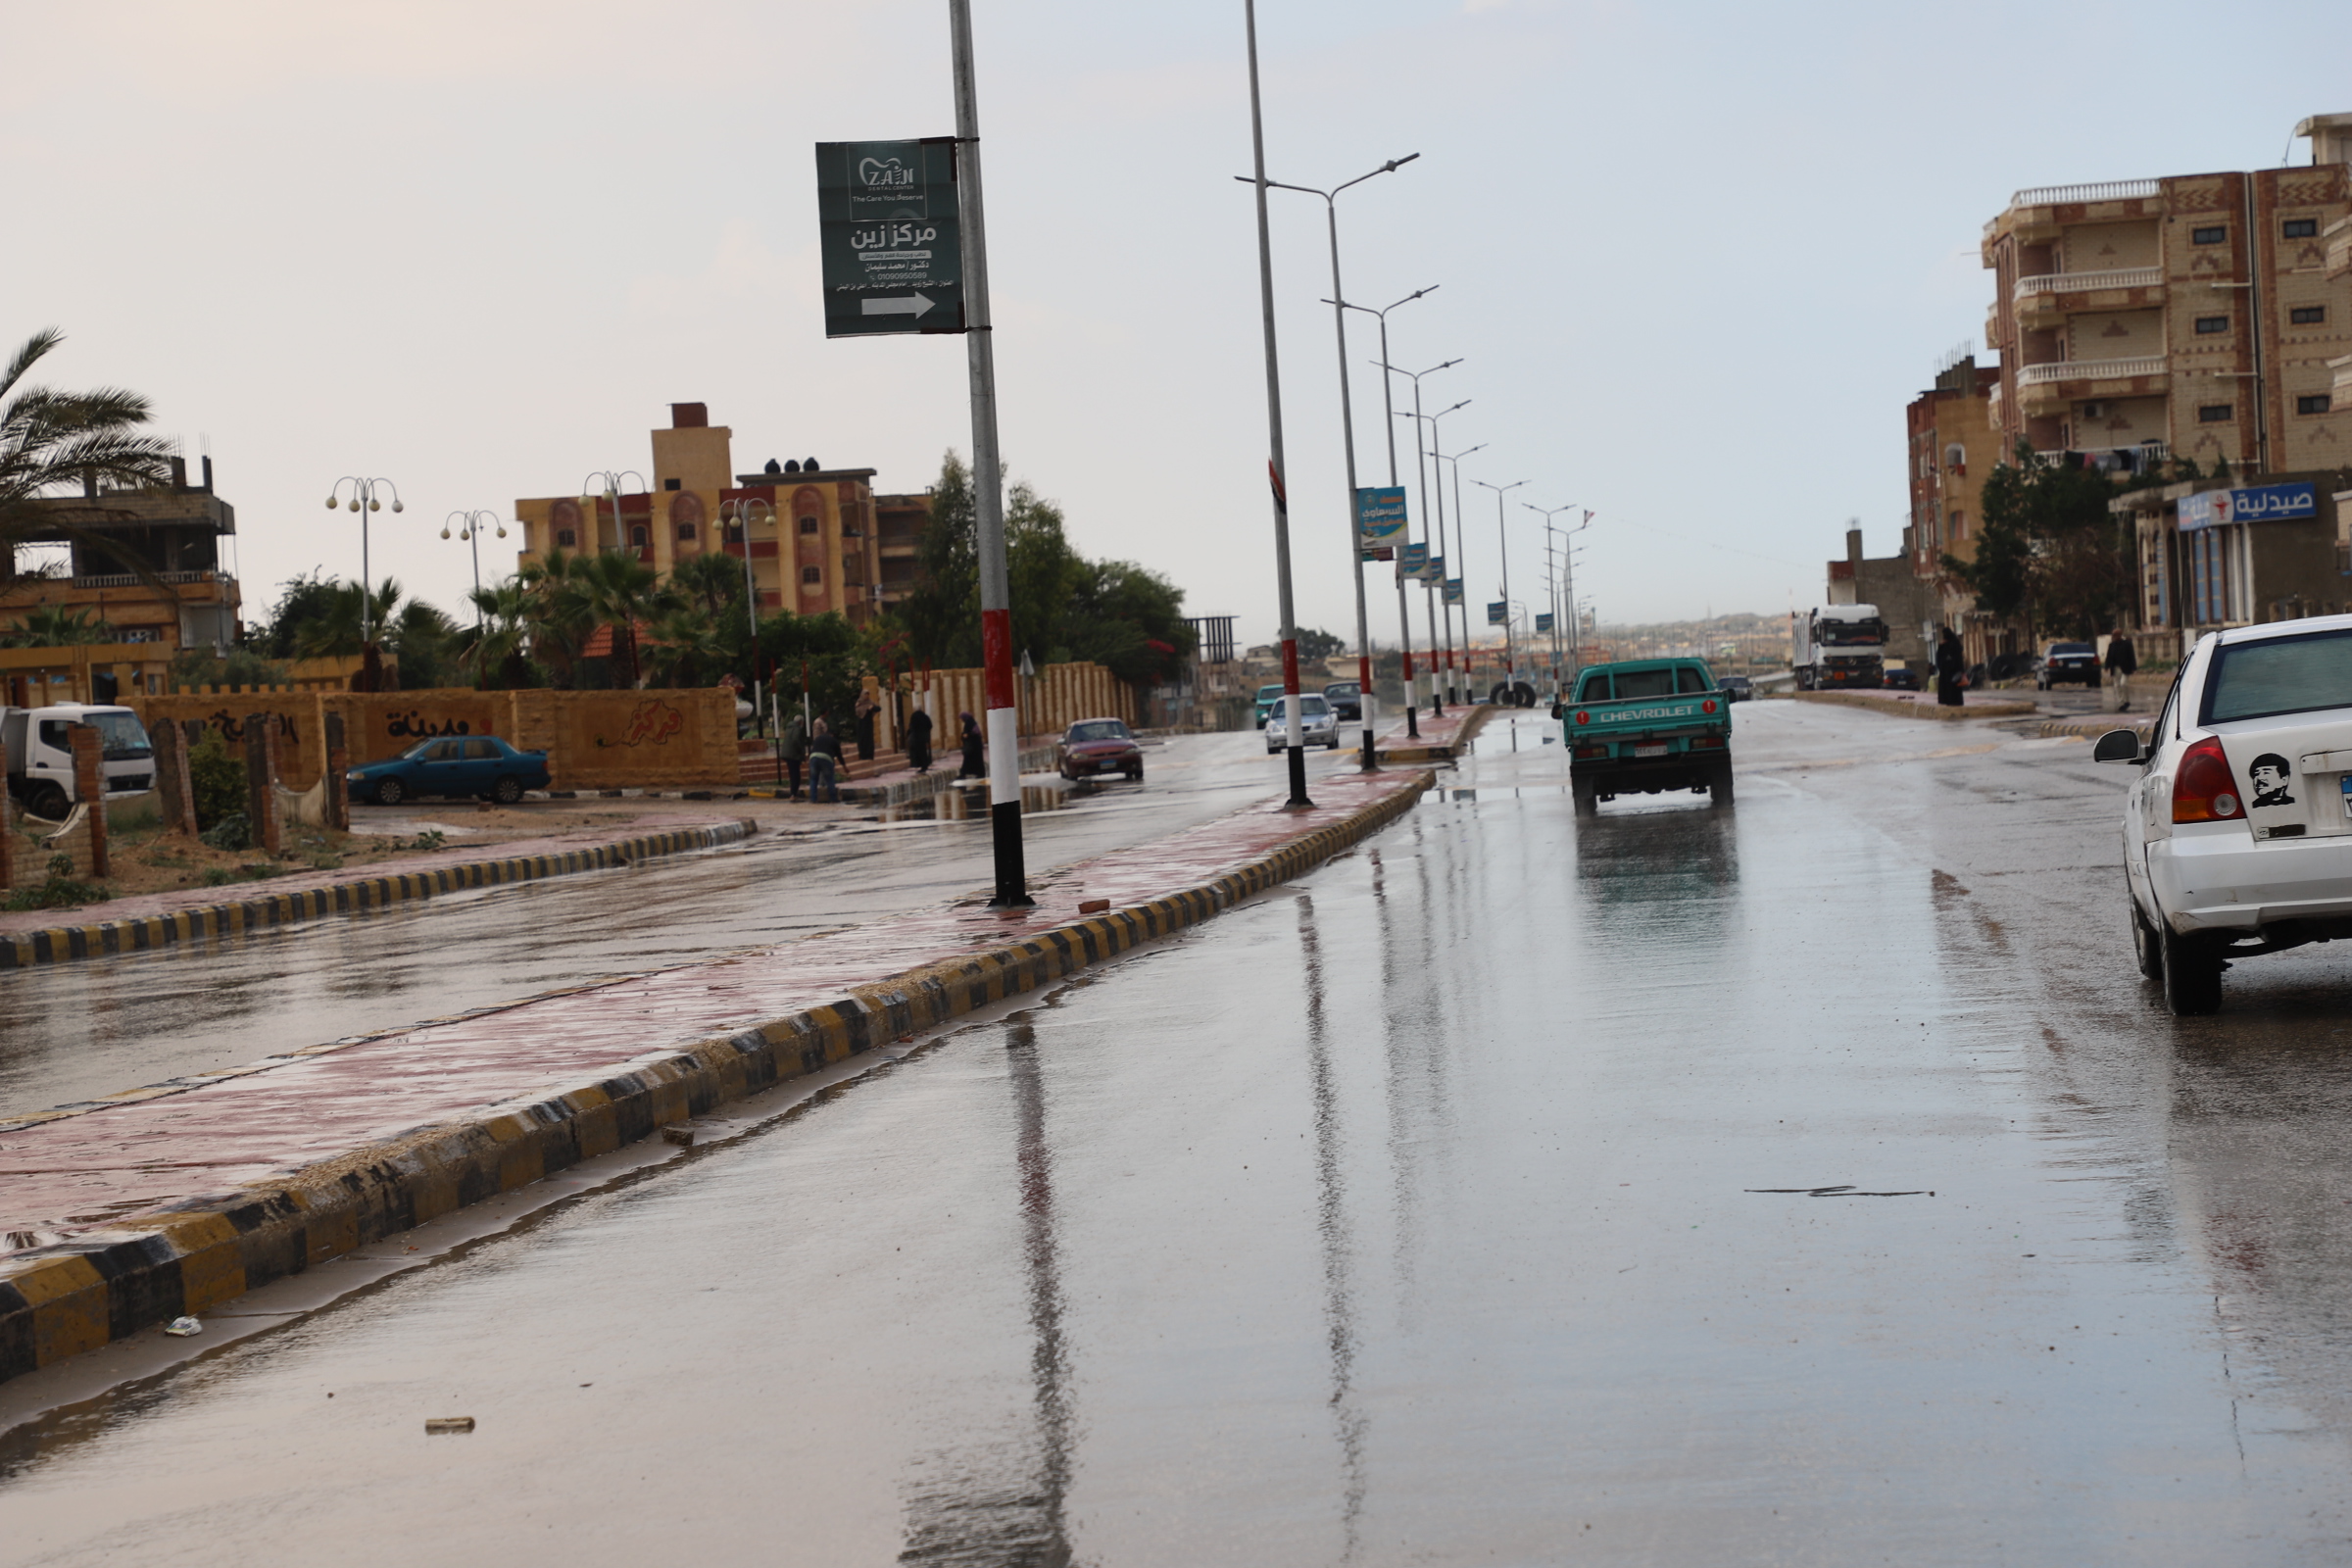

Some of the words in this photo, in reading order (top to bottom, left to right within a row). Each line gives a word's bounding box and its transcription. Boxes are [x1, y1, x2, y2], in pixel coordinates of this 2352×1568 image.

[851, 224, 886, 249] زين
[890, 223, 937, 247] مركز
[864, 263, 887, 272] سليمان
[2236, 492, 2314, 517] صيدلية
[1600, 705, 1694, 723] CHEVROLET
